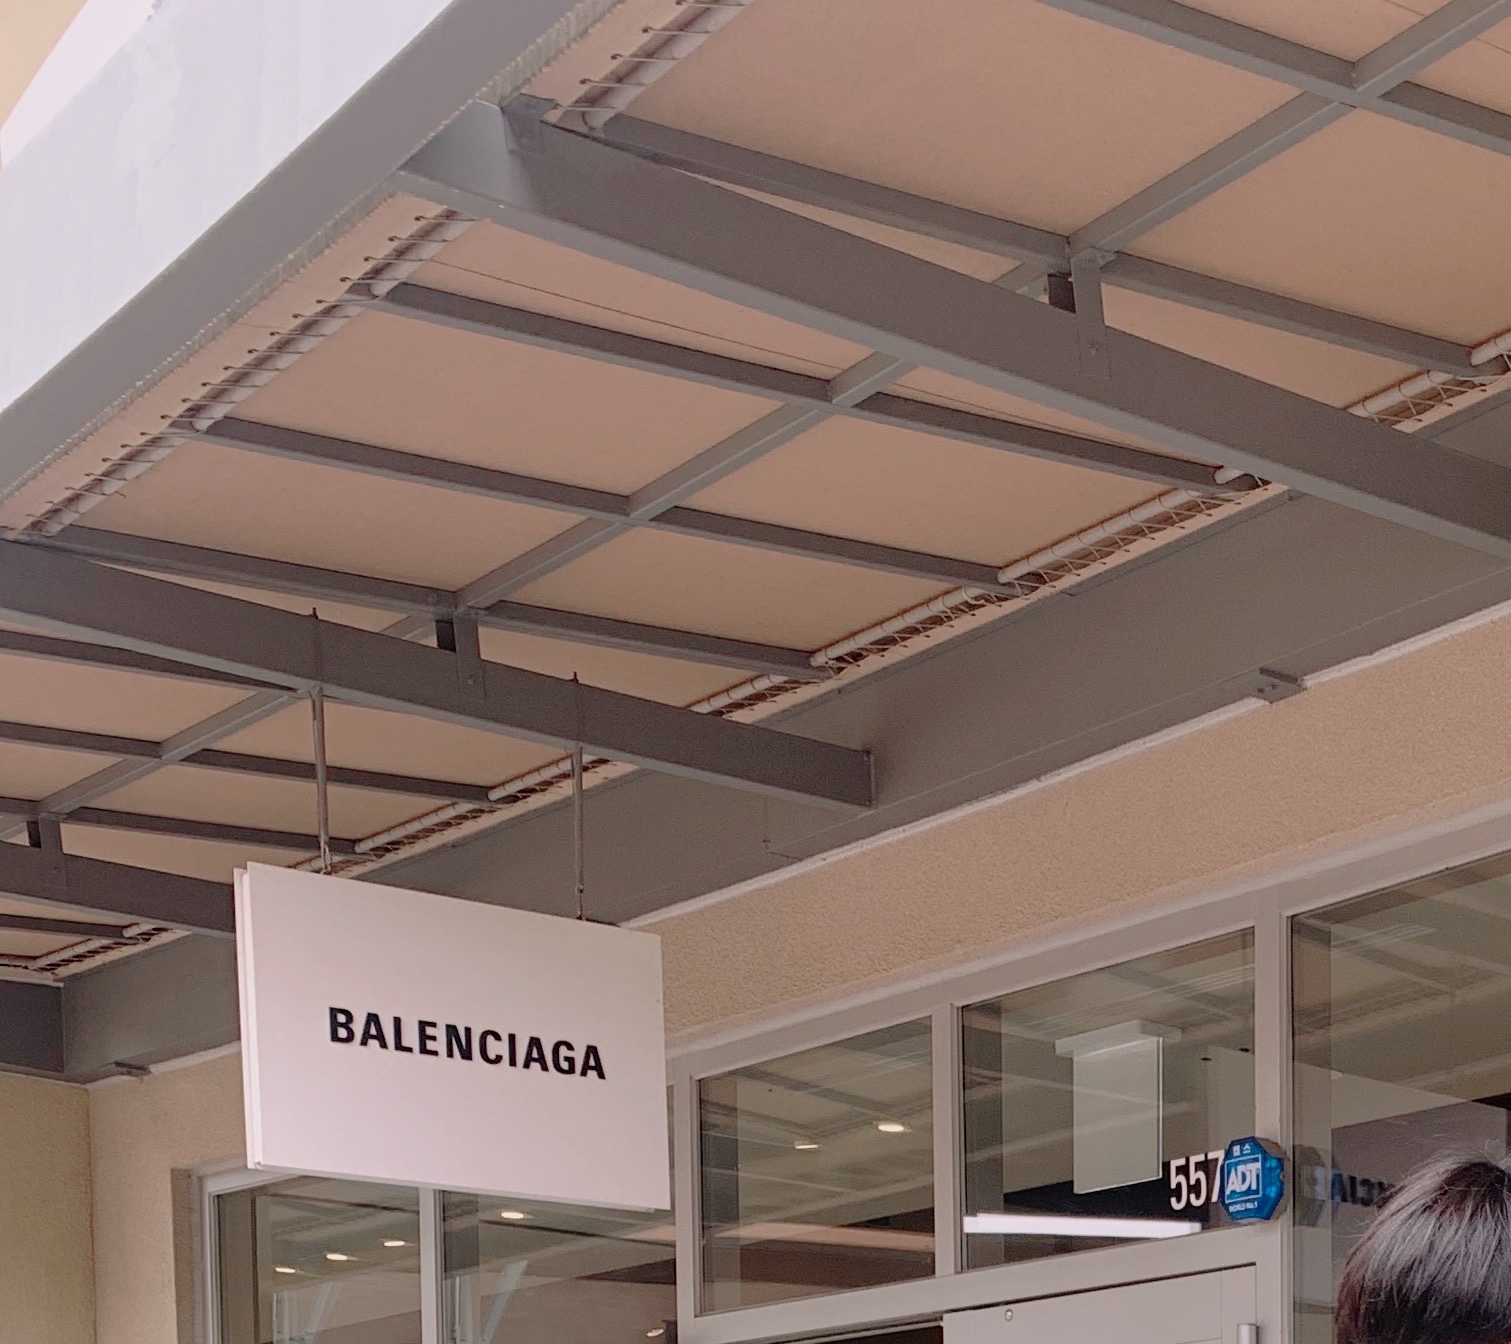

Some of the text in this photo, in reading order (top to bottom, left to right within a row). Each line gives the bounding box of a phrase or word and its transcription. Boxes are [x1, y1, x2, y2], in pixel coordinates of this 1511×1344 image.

[328, 1006, 606, 1080] BALENCIAGA
[1170, 1149, 1225, 1211] 557
[1226, 1162, 1260, 1196] ADT
